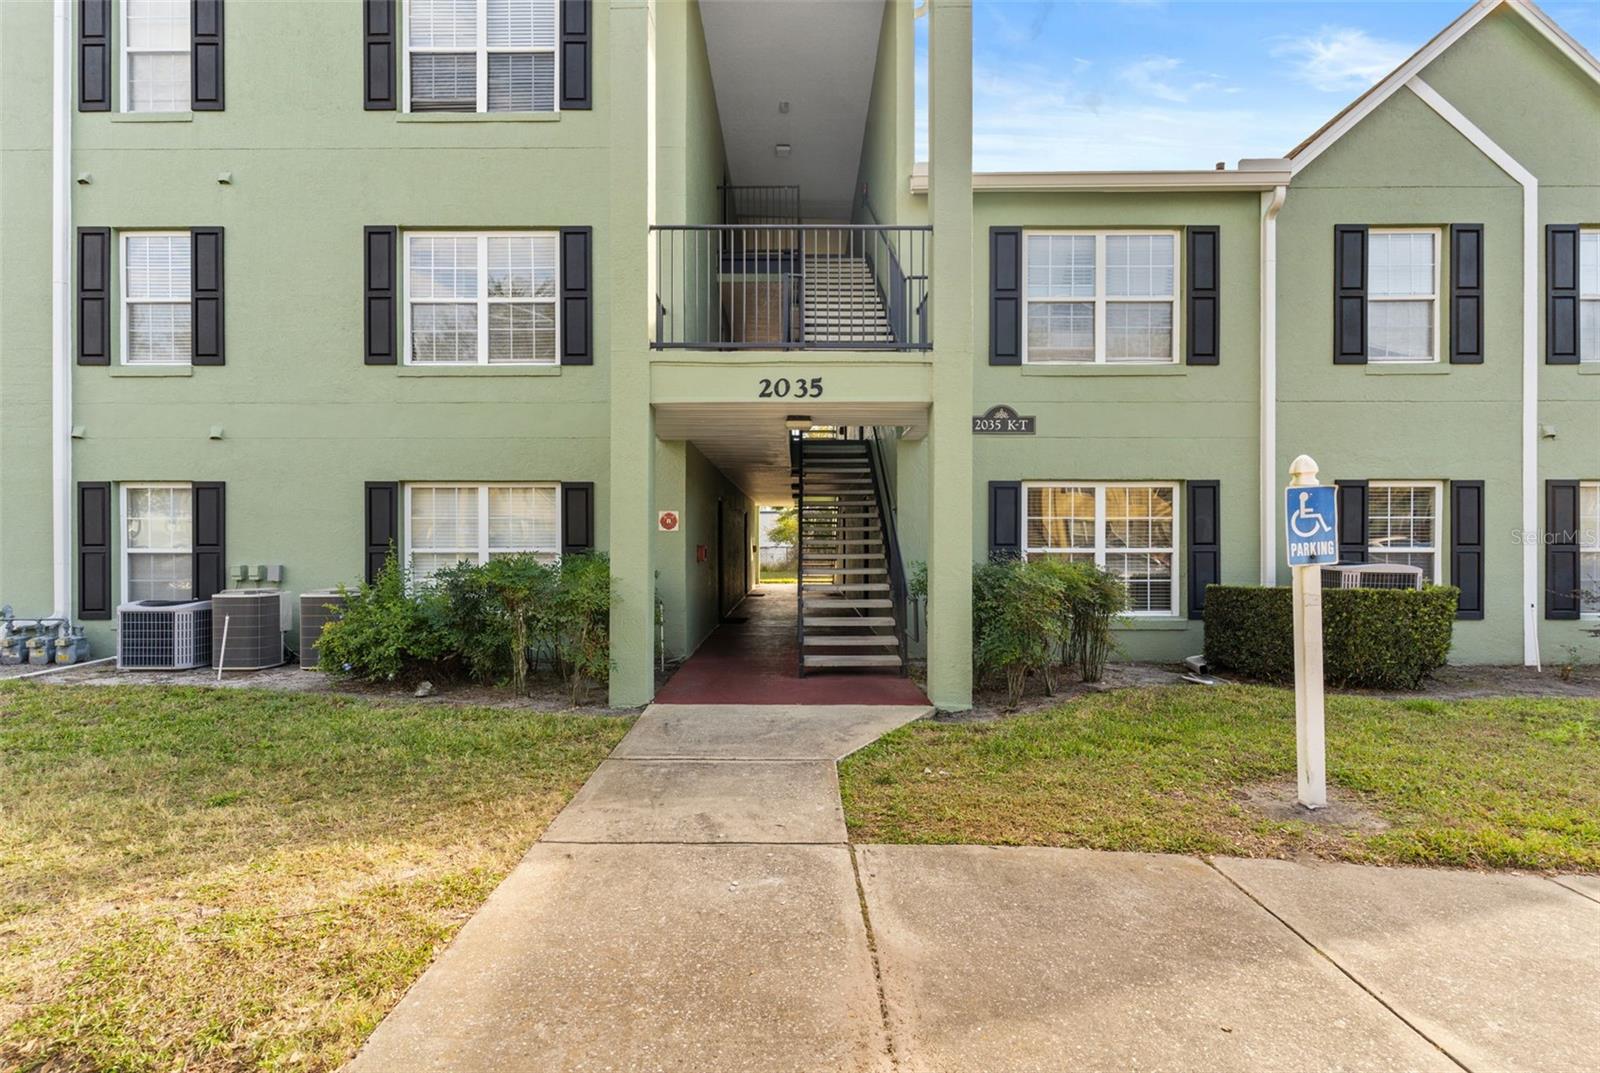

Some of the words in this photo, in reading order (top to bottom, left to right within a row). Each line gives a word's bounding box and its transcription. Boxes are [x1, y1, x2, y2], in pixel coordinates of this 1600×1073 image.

[758, 376, 823, 398] 2035
[974, 419, 1001, 430] 2035
[1007, 419, 1028, 431] K-T
[1290, 540, 1334, 557] PARKING
